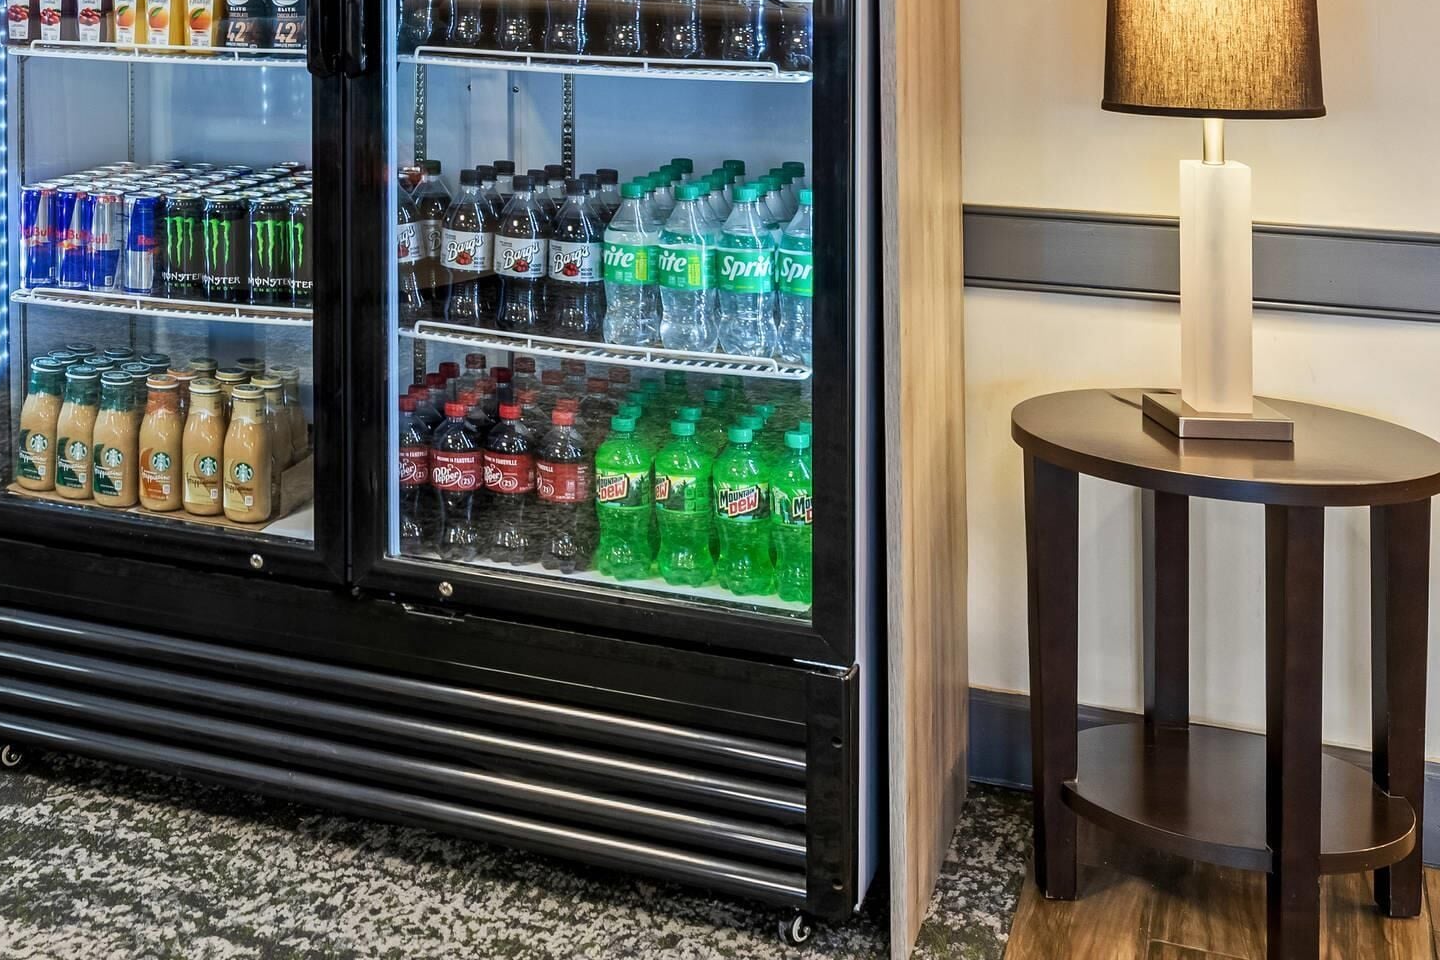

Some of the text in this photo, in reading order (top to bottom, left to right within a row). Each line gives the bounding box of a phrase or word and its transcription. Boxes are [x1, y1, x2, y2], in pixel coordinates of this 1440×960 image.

[447, 234, 484, 262] Barq's
[503, 241, 540, 270] Barq's
[553, 245, 591, 274] Barq's
